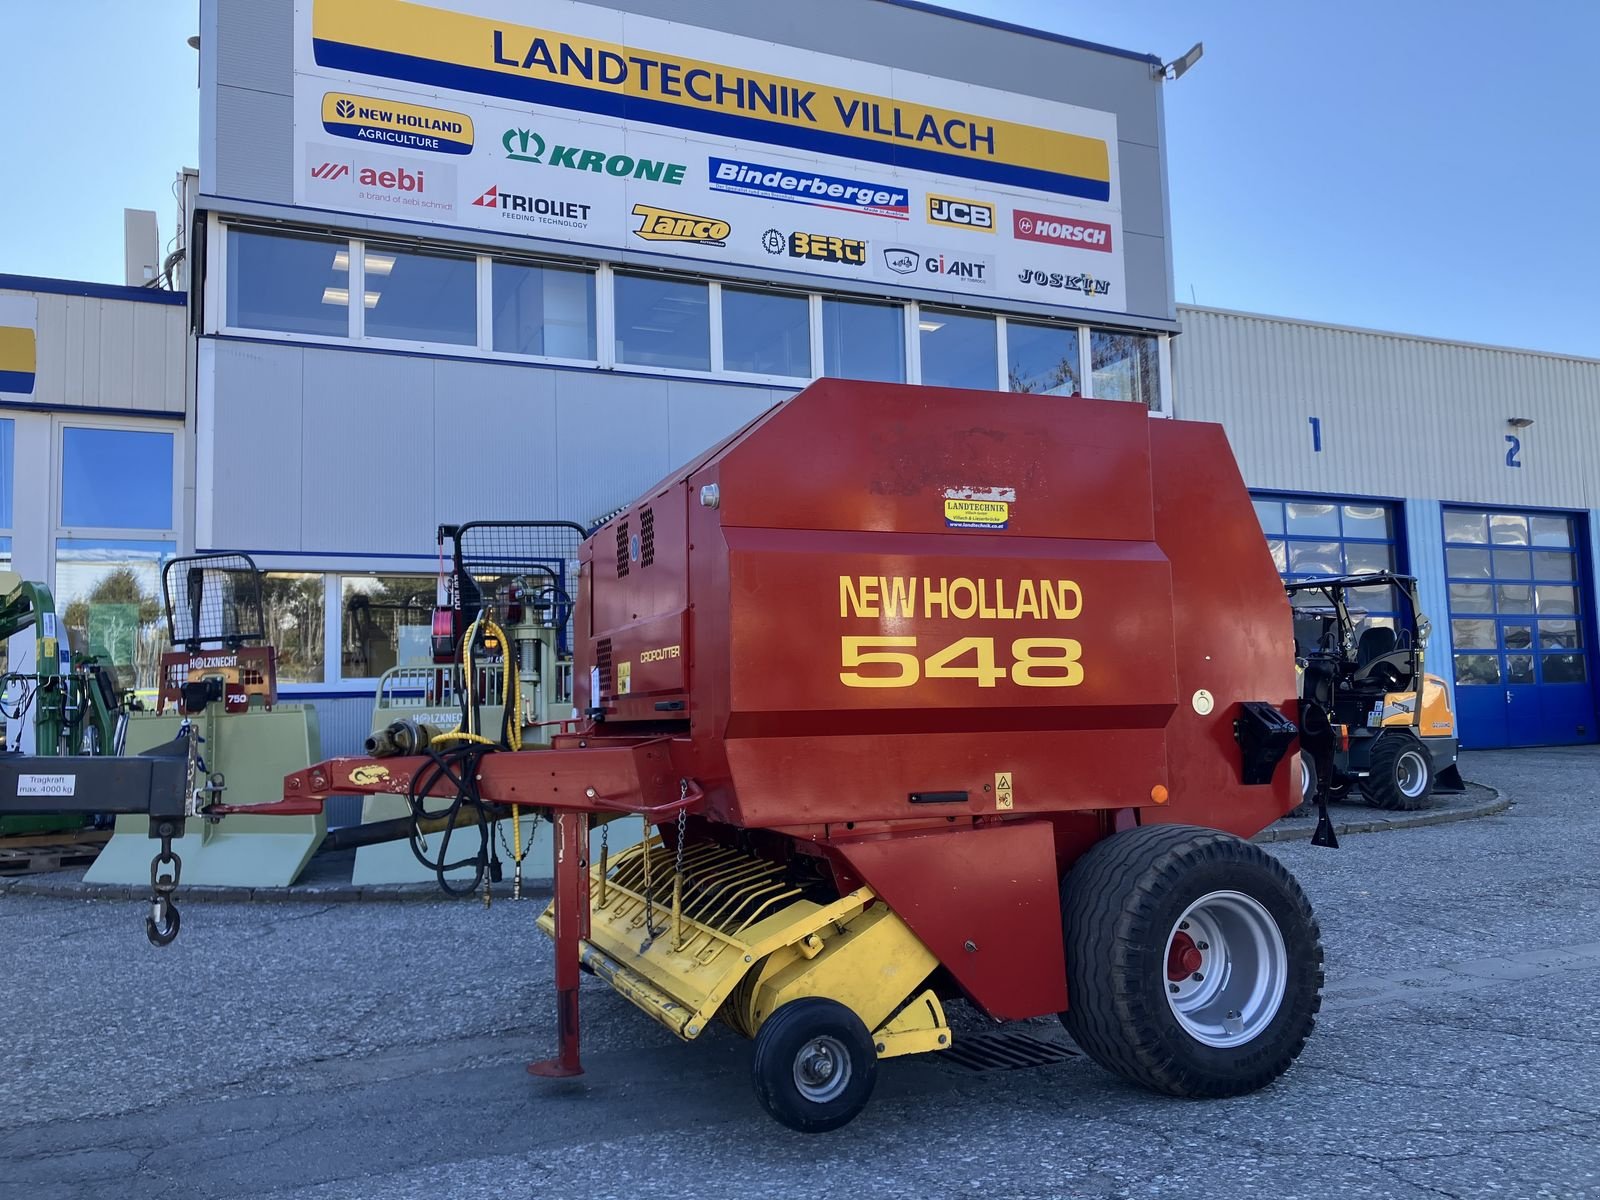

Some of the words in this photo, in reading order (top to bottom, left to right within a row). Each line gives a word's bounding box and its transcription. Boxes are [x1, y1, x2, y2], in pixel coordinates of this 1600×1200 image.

[493, 29, 816, 123] LANDTECHNIK
[833, 96, 995, 156] VILLACH
[359, 107, 392, 123] NEW
[397, 113, 462, 134] HOLLAND
[357, 128, 439, 149] AGRICULTURE
[548, 145, 687, 185] KRONE
[359, 167, 424, 193] aebi
[715, 162, 904, 207] Binderberger
[366, 192, 391, 202] brand
[402, 197, 420, 206] aebi
[421, 200, 453, 210] schmidt
[498, 192, 591, 221] TRIOLIET
[931, 199, 992, 228] JCB
[502, 212, 535, 222] FEEDING
[538, 216, 588, 229] TECHNOLOGY
[631, 204, 731, 242] Tanco
[1034, 219, 1107, 245] HORSCH
[1017, 268, 1111, 297] JOSKIN
[1308, 416, 1322, 452] 1
[1504, 434, 1521, 468] 2
[947, 502, 1005, 512] LANDTECHNIK
[839, 575, 915, 618] NEW
[924, 577, 1083, 620] HOLLAND
[189, 655, 238, 669] HOLZKNECHT
[640, 645, 680, 664] CROPCUTTER
[839, 636, 1085, 688] 548
[227, 694, 247, 703] 750
[30, 776, 65, 784] Tragkraft
[40, 785, 61, 793] 4000
[62, 785, 73, 794] kg
